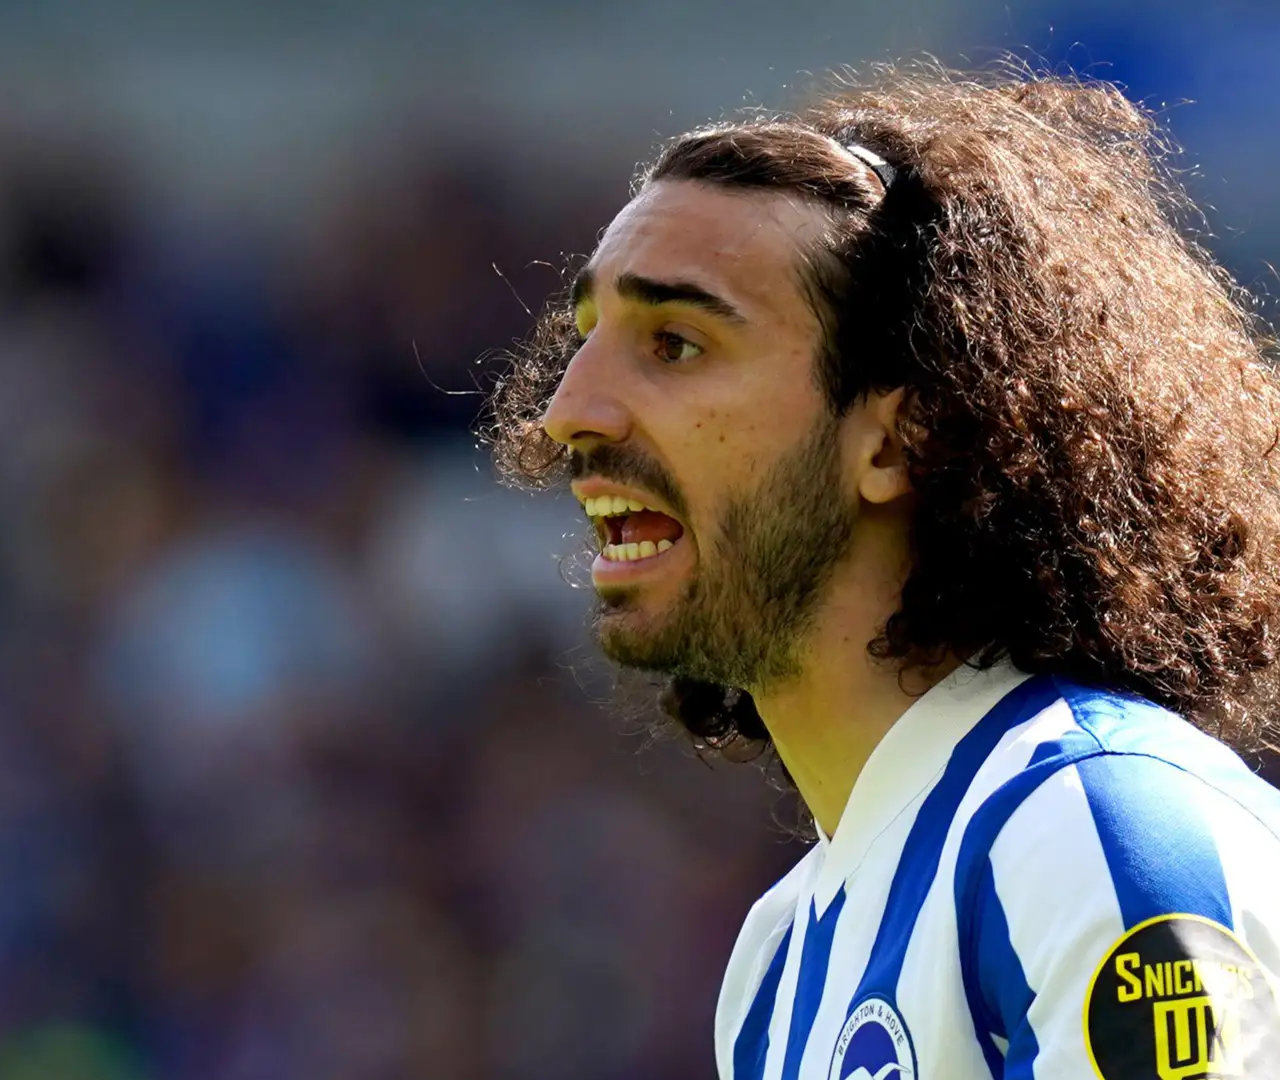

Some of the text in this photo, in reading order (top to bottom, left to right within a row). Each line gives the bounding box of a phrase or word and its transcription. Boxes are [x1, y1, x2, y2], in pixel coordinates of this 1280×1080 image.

[838, 1004, 905, 1056] BRIGHTON & HOVE
